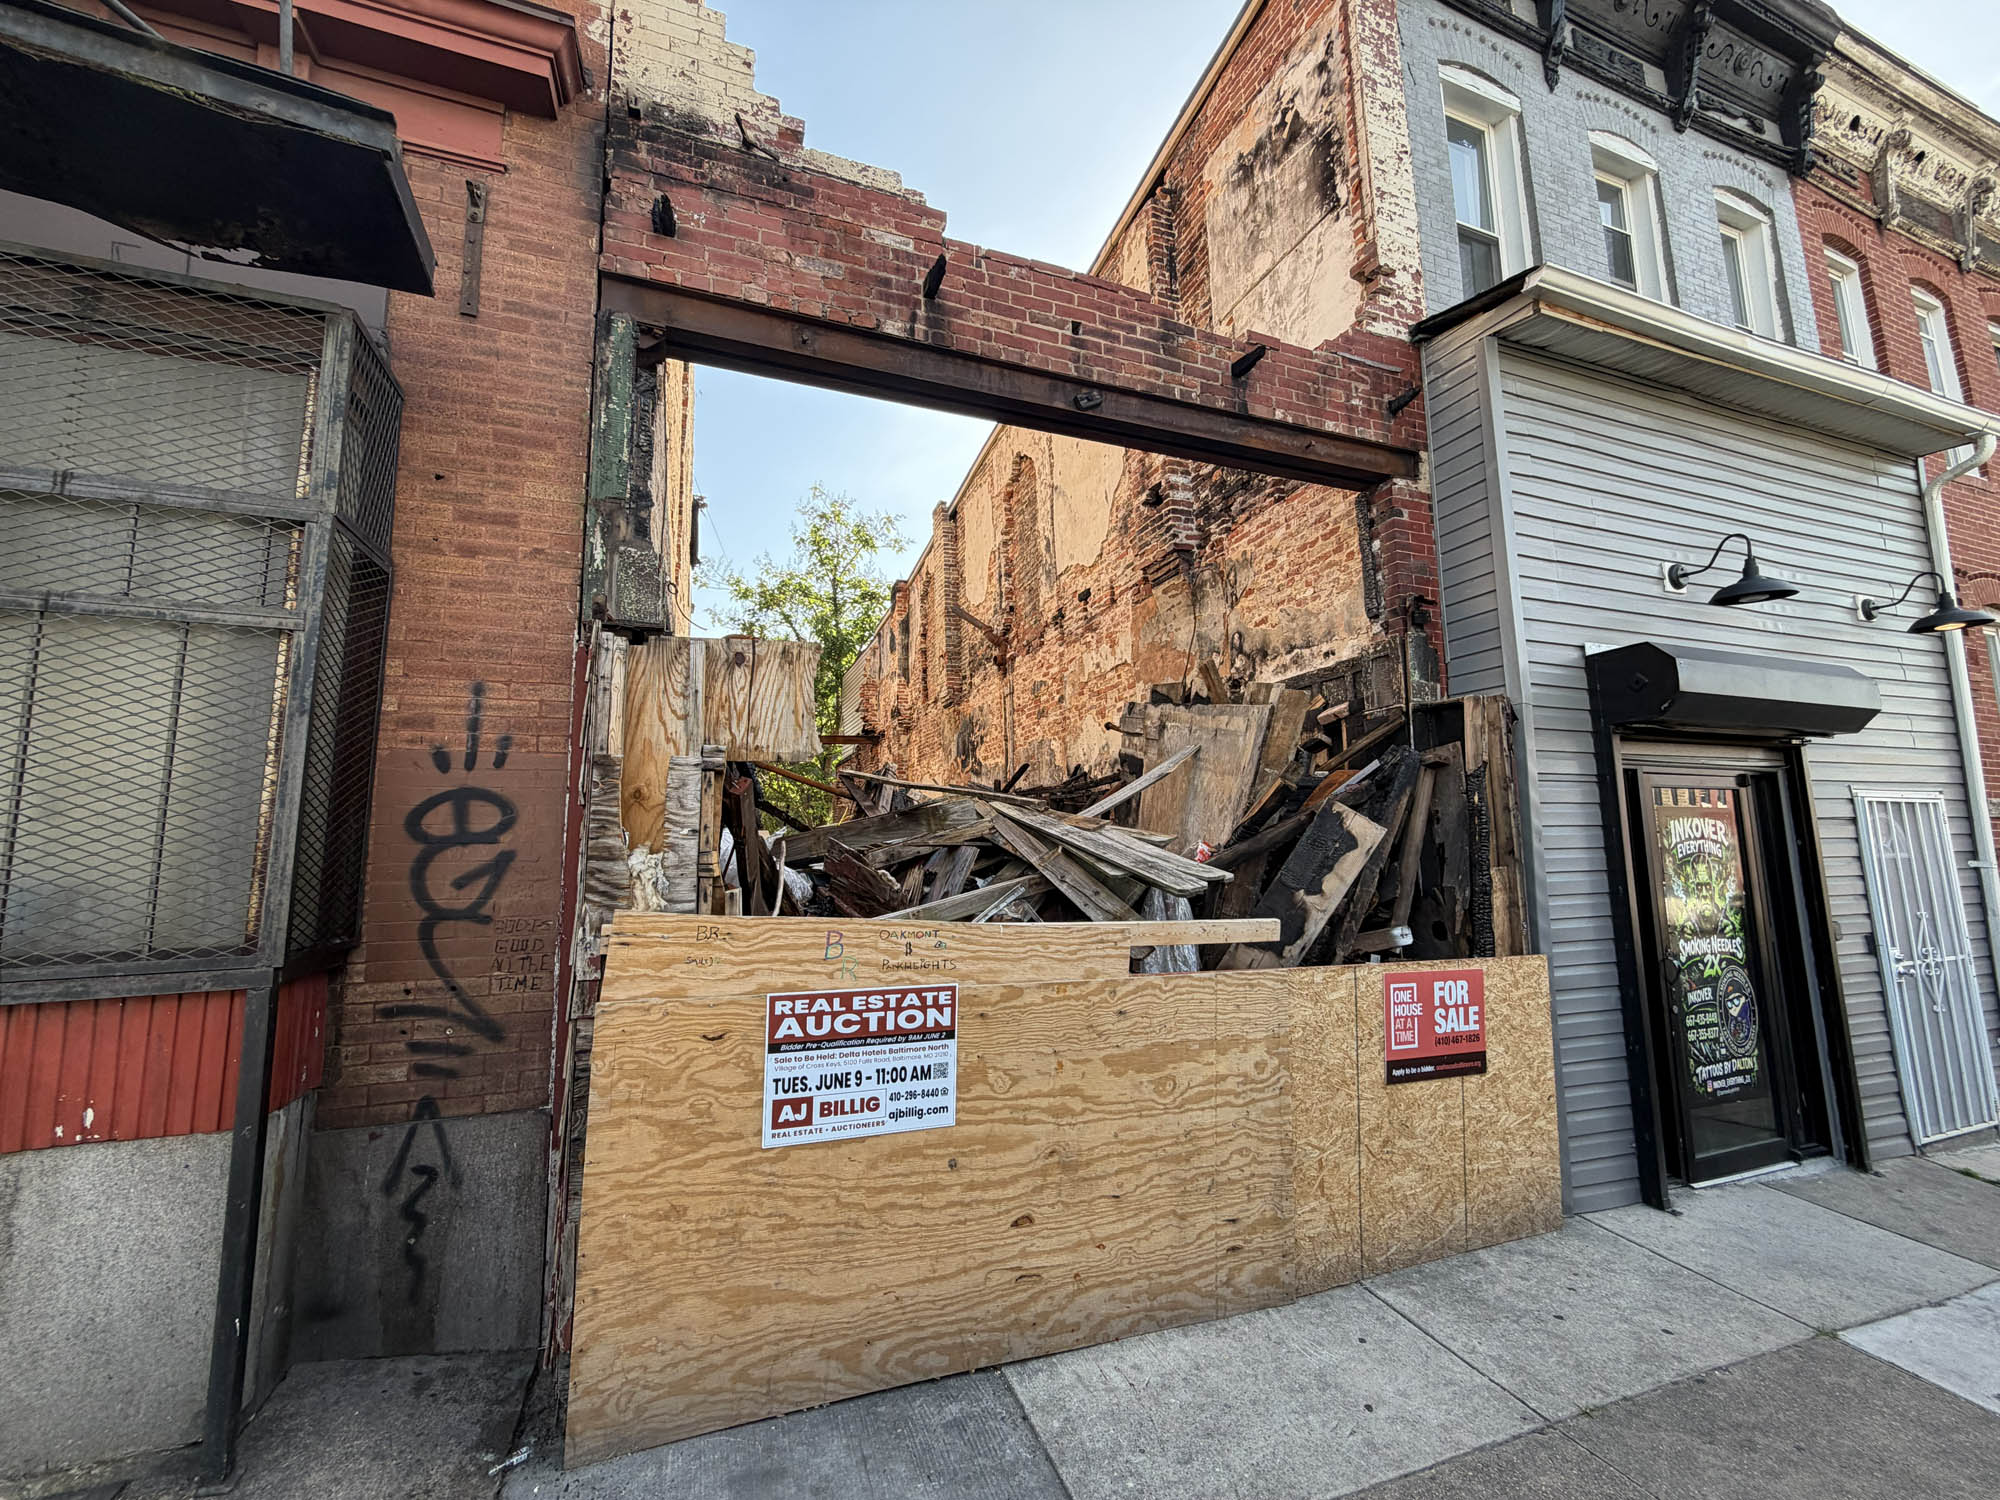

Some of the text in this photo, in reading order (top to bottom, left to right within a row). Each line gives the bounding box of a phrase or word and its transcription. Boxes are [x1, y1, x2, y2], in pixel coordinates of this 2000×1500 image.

[1670, 817, 1729, 849] INKOVER
[1677, 839, 1723, 859] EVERYTHING
[879, 929, 940, 940] OAKMONT
[1679, 934, 1744, 963] SMOKING NEEDLES
[1703, 954, 1722, 978] 2X
[774, 991, 953, 1016] REAL ESTATE
[1394, 990, 1412, 1003] ONE
[1433, 980, 1469, 1007] FOR
[1687, 987, 1713, 1006] INKOVER
[1395, 1003, 1423, 1017] HOUSE
[1434, 1006, 1480, 1034] SALE
[773, 1006, 952, 1040] AUCTION
[1395, 1018, 1413, 1030] AT A
[780, 1043, 804, 1052] Bidder
[805, 1038, 865, 1050] Pre-Qualification
[866, 1034, 896, 1045] Required
[897, 1034, 907, 1044] by
[908, 1033, 923, 1041] 9AM
[923, 1032, 938, 1040] JUNE
[1395, 1030, 1414, 1042] TIME
[1434, 1036, 1450, 1047] (410)
[774, 1043, 949, 1065] Sale to Be Held: Delta Hotels Baltimore North
[774, 1064, 797, 1073] Village
[798, 1062, 805, 1070] of
[806, 1061, 823, 1070] Cross
[1392, 1068, 1405, 1077] Apply
[1695, 1056, 1754, 1084] TATTOOS BY DALTON
[772, 1074, 813, 1095] TUES.
[815, 1071, 852, 1091] JUNE
[854, 1069, 863, 1087] 9
[875, 1066, 907, 1086] 11:00
[910, 1064, 932, 1082] AM
[889, 1088, 940, 1102] 410-296-8440
[778, 1096, 881, 1123] AJ BILLIG
[888, 1104, 949, 1122] ajbillig.com
[771, 1120, 886, 1140] REAL ESTATE AUCTIONEERS
